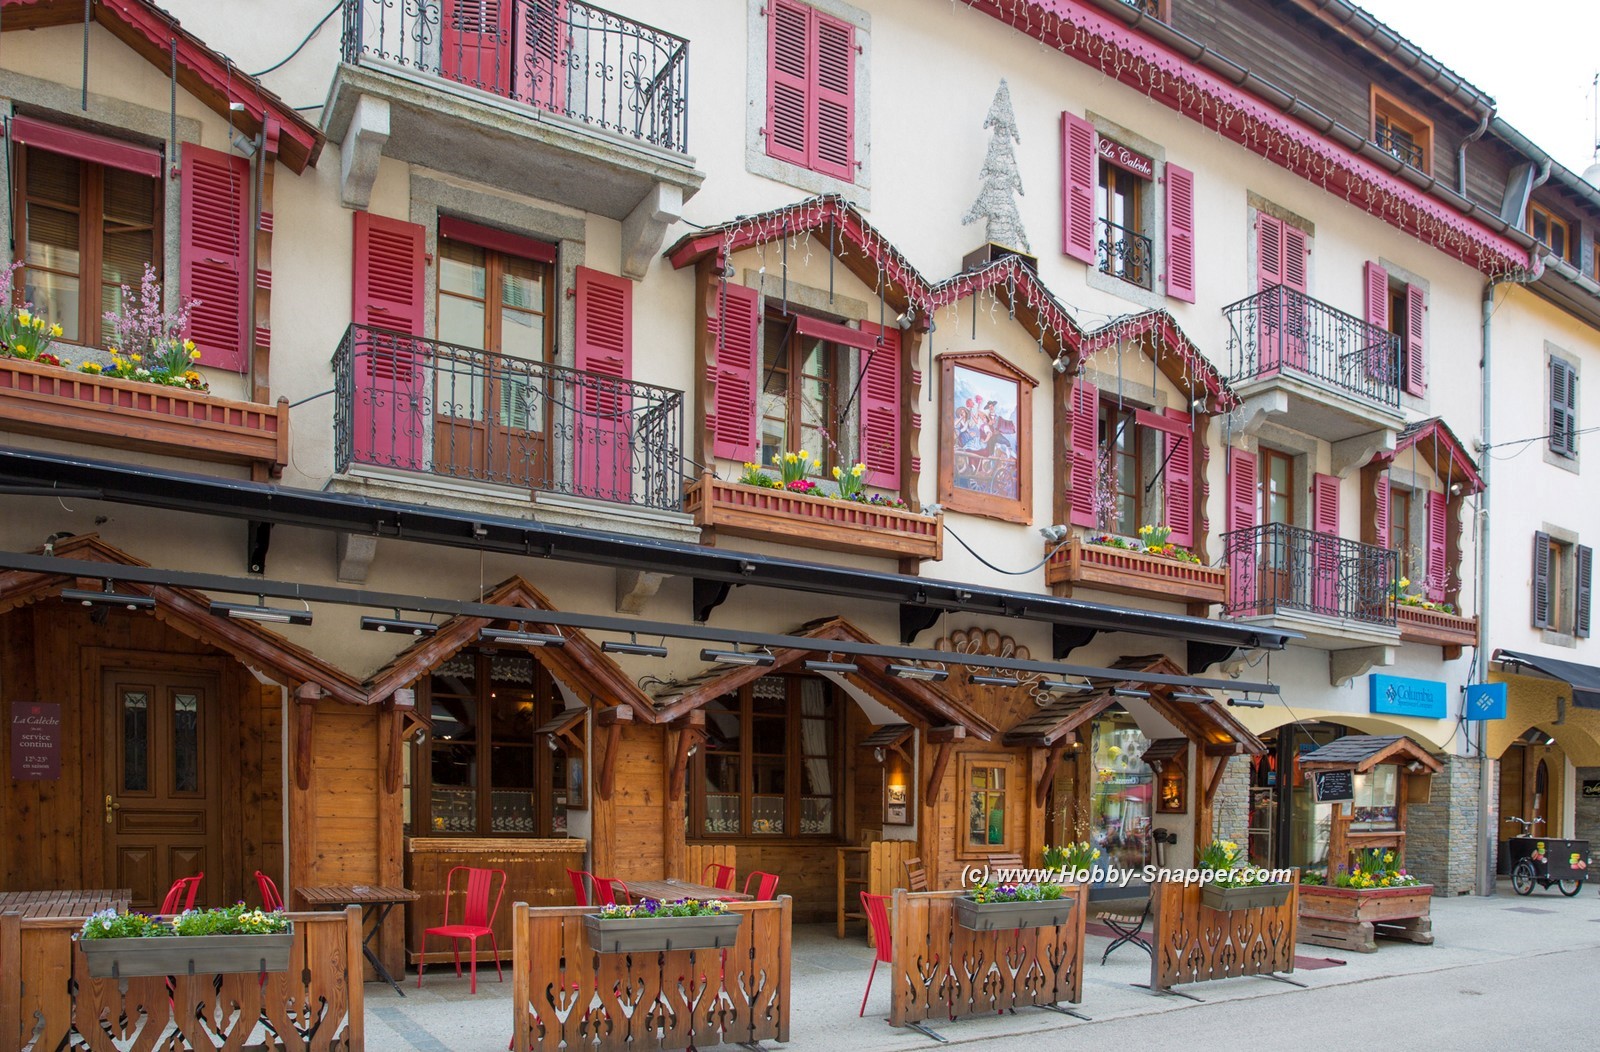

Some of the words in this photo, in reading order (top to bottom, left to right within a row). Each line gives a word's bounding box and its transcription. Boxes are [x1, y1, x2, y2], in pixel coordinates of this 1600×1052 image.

[1099, 138, 1115, 159] La
[1397, 685, 1433, 702] Columbia
[13, 716, 26, 724] La
[27, 716, 59, 725] Calèche
[21, 733, 51, 741] service
